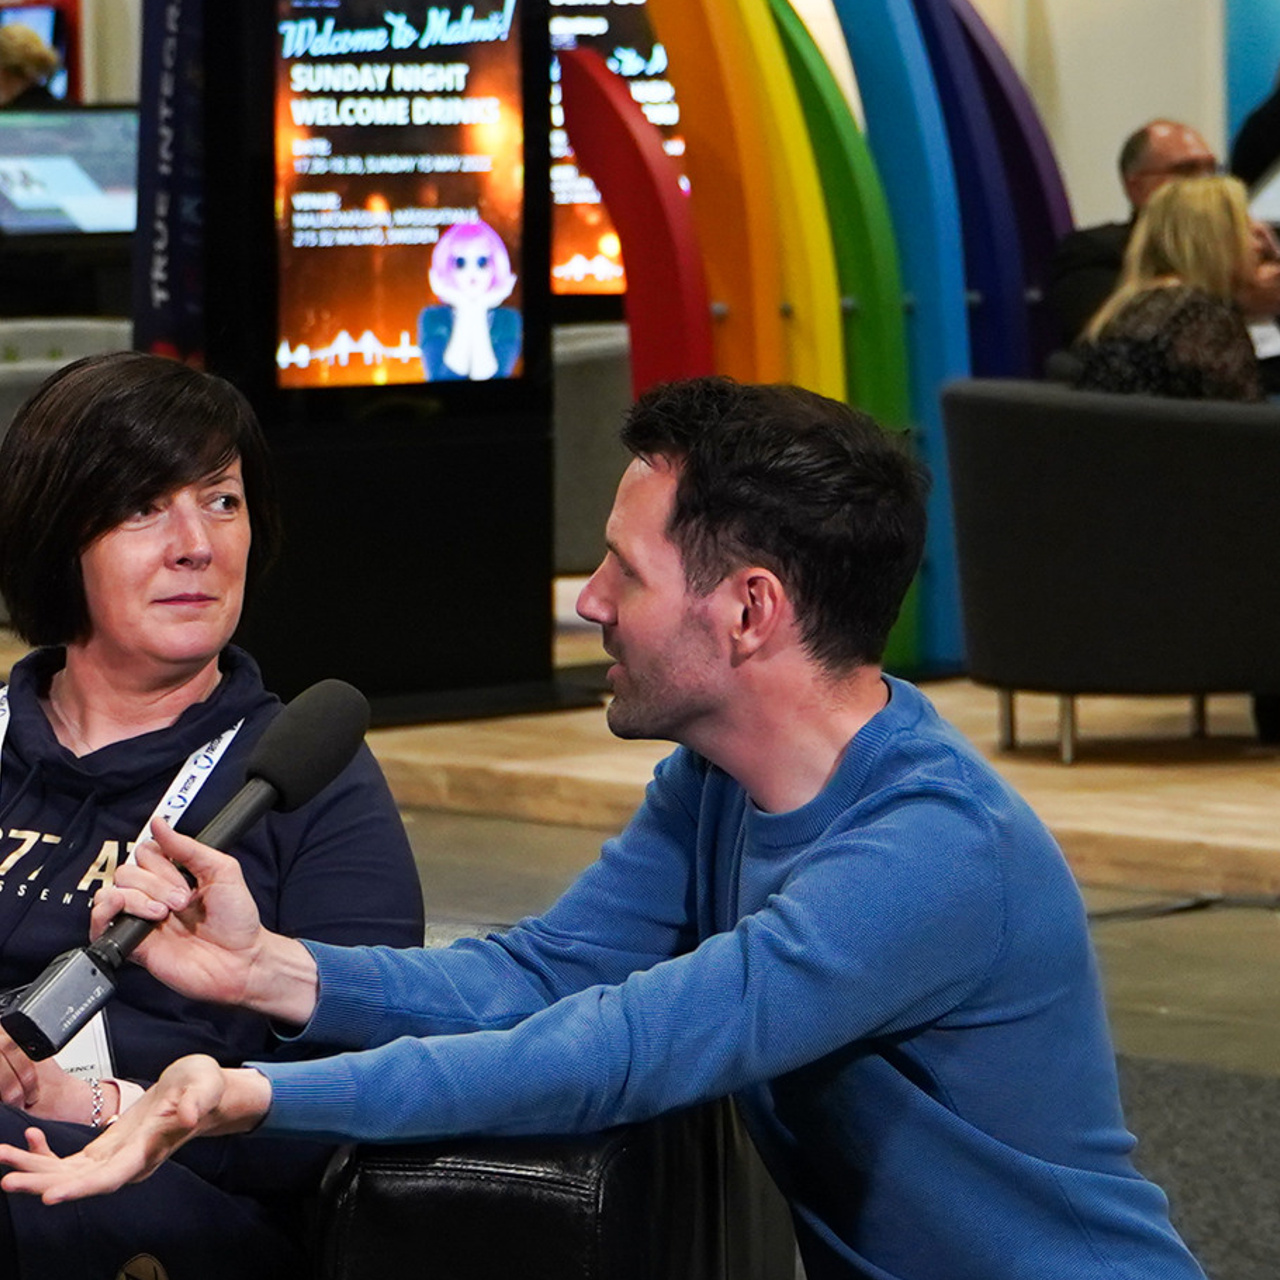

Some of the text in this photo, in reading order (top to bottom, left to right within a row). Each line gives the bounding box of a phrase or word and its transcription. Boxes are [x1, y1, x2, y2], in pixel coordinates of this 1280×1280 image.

[278, 17, 389, 59] Welcome
[290, 63, 470, 92] SUNDAY NIGHT
[290, 97, 501, 126] WELCOME DRINKS
[150, 189, 170, 309] TRUE
